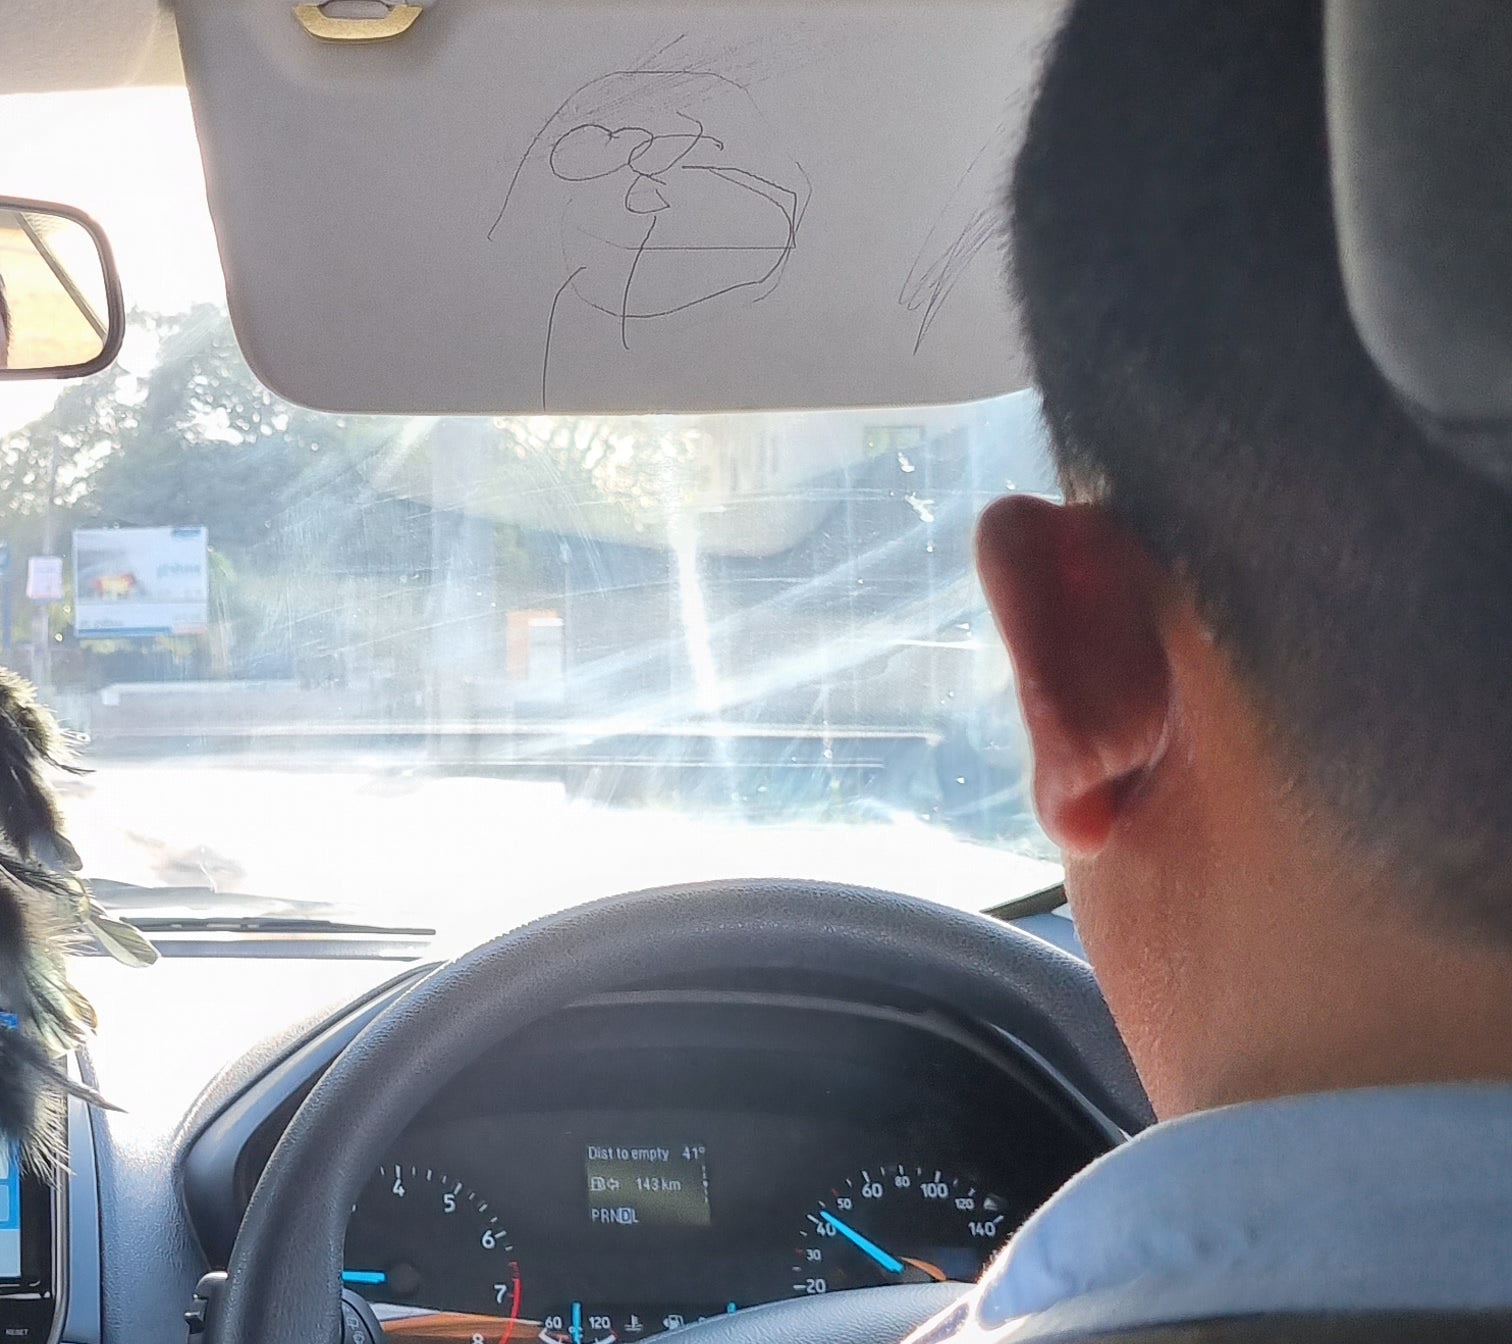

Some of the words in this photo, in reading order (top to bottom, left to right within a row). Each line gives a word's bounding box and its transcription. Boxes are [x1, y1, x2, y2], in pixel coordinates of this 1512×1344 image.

[588, 1146, 613, 1160] Dist
[616, 1147, 629, 1160] to
[631, 1147, 670, 1162] empty
[392, 1178, 406, 1197] 4
[636, 1177, 659, 1191] 143
[661, 1177, 682, 1191] km
[861, 1182, 883, 1198] 60
[894, 1176, 910, 1188] 80
[920, 1182, 949, 1198] 100
[443, 1193, 456, 1213] 5
[837, 1198, 852, 1210] 50
[954, 1198, 975, 1210] 120
[815, 1222, 837, 1237] 40
[968, 1221, 996, 1237] 140
[481, 1230, 496, 1249] 6
[806, 1248, 822, 1261] 30
[493, 1284, 507, 1304] 7
[806, 1278, 826, 1294] 20
[544, 1316, 563, 1329] 60
[588, 1316, 611, 1329] 120
